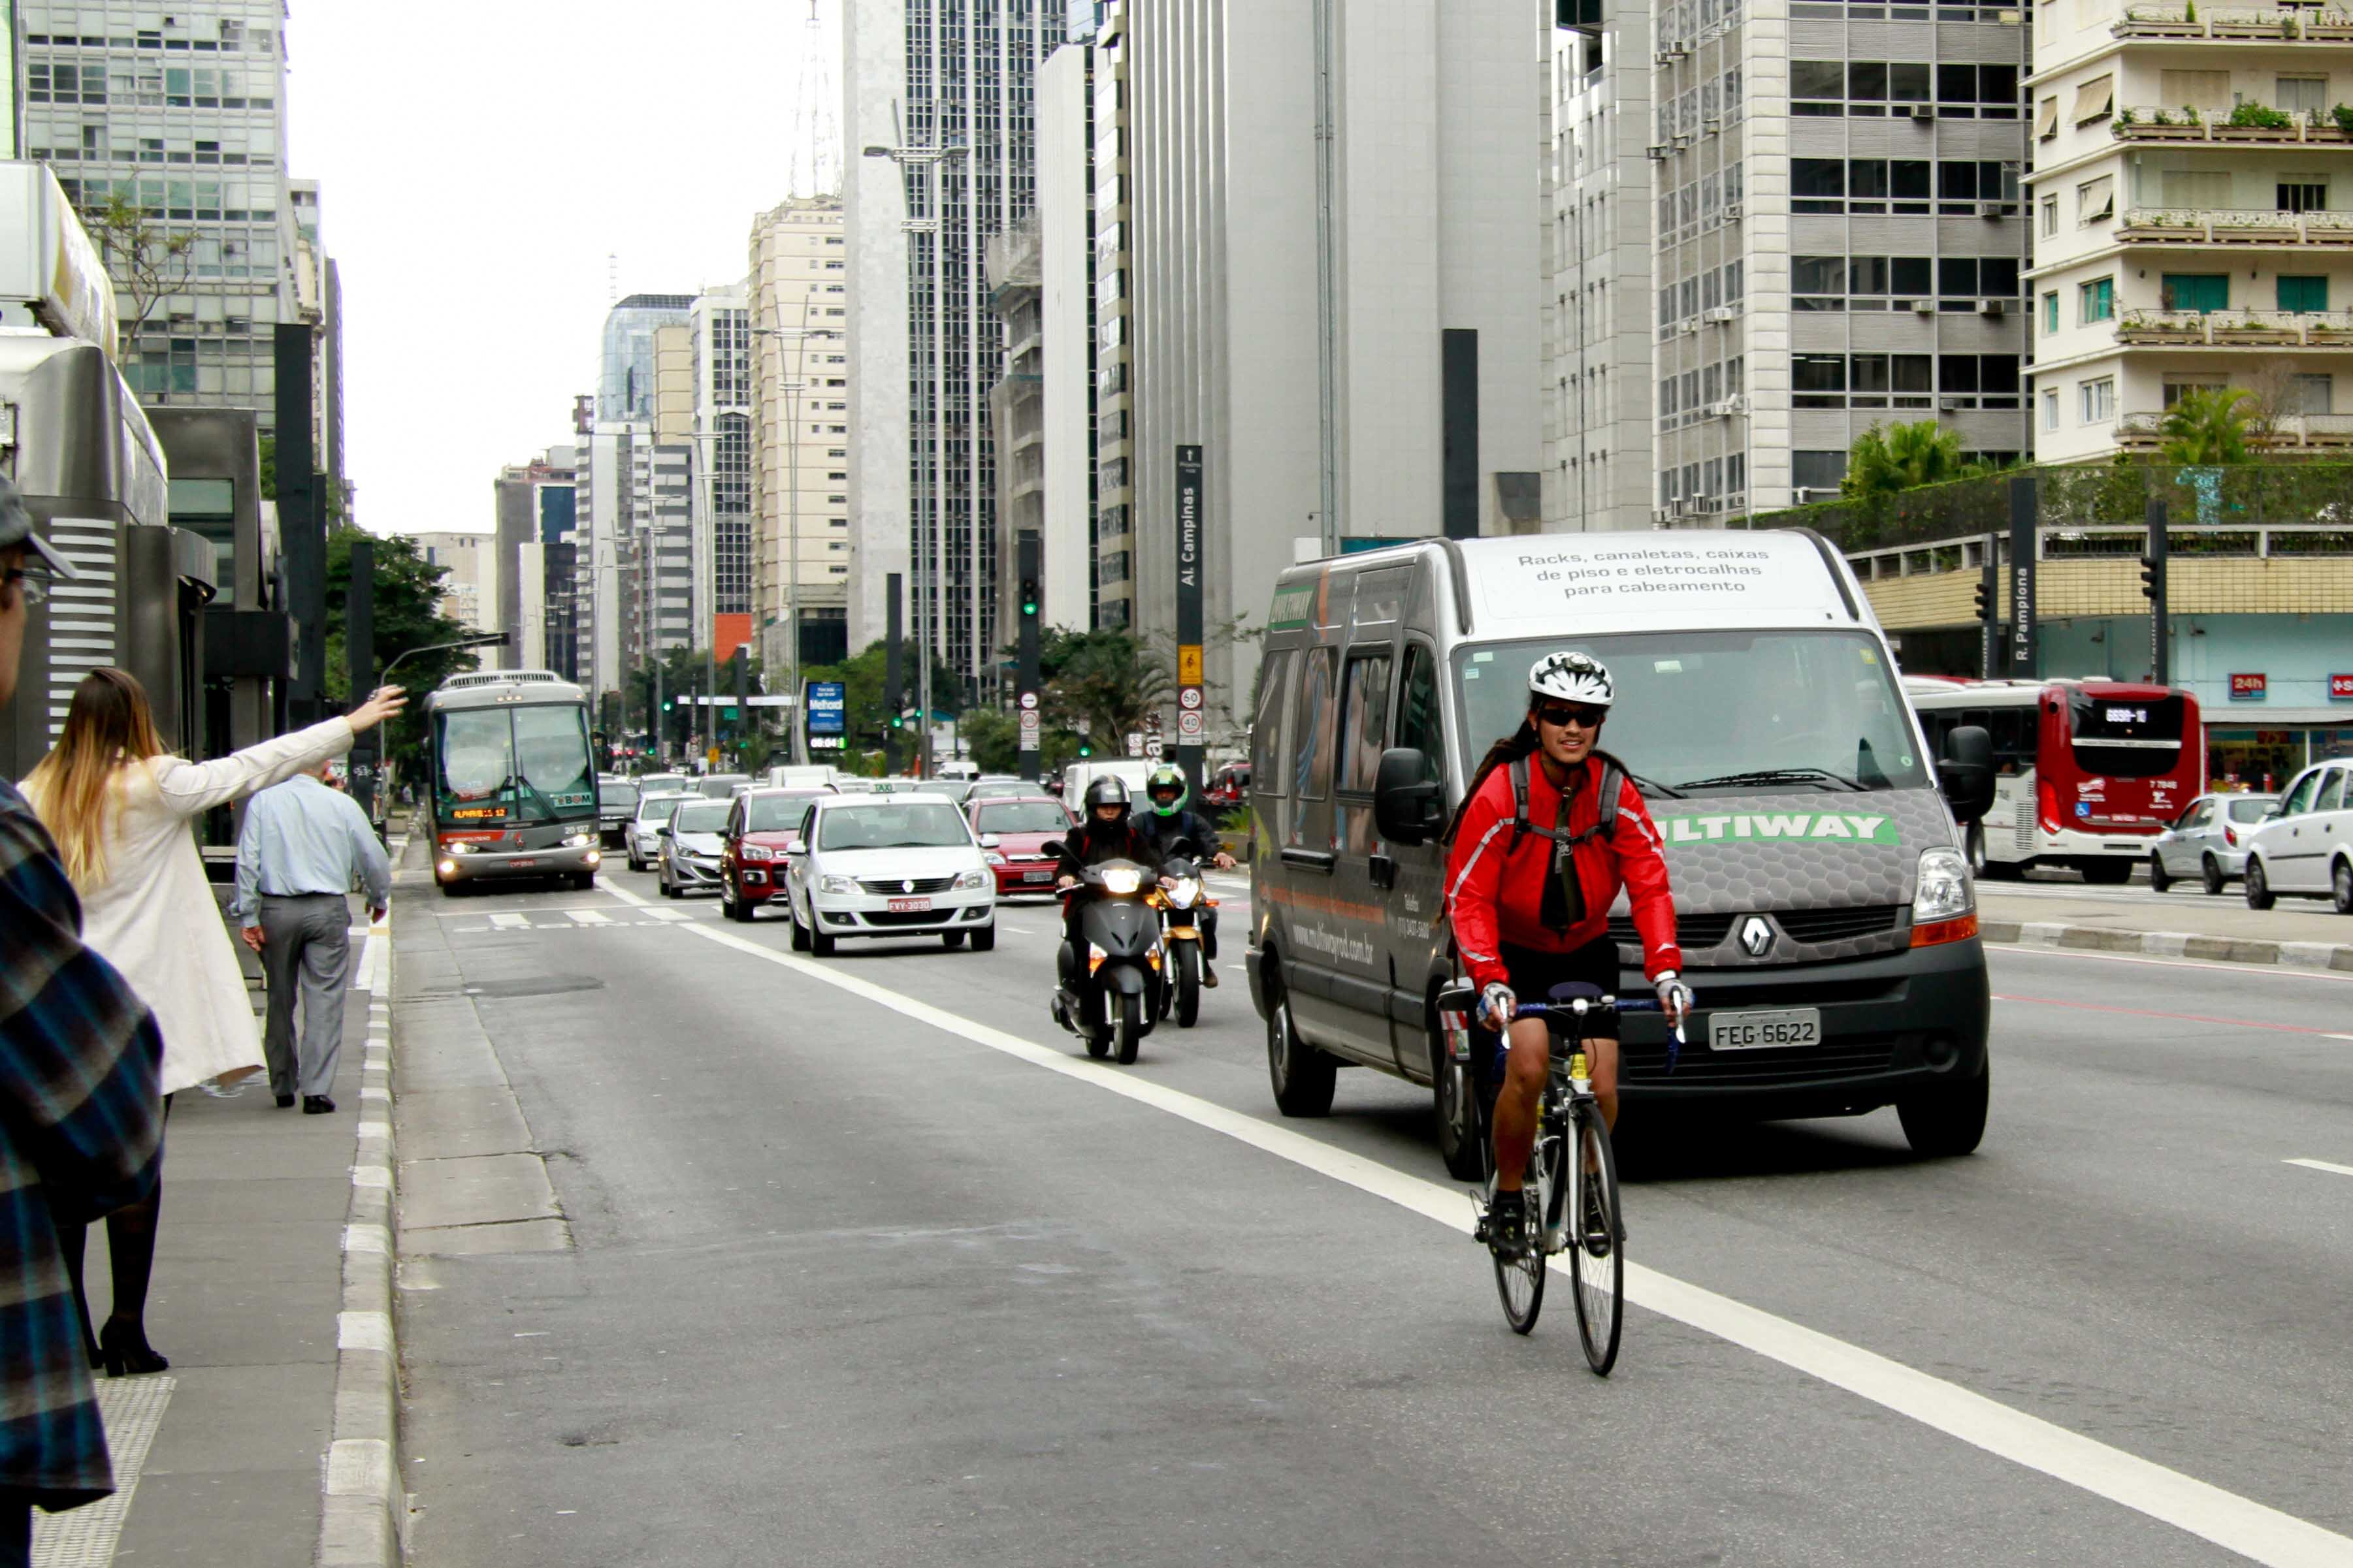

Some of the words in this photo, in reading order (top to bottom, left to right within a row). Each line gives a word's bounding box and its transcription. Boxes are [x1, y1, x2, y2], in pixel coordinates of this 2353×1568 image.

[1181, 487, 1196, 563] Campinas
[1517, 553, 1588, 567] Racks,
[1594, 549, 1700, 561] canaletas,
[1706, 549, 1769, 560] caixas
[1181, 568, 1195, 586] Al.
[1536, 570, 1561, 581] de
[1568, 568, 1610, 582] piso
[1617, 568, 1628, 576] e
[1634, 564, 1762, 576] eletrocalhas
[1564, 585, 1612, 598] para
[1619, 581, 1745, 593] cabeamento
[2015, 568, 2030, 643] Pamplona
[2015, 647, 2028, 660] R.
[2234, 677, 2264, 689] 24h
[1184, 693, 1197, 702] 60
[1715, 1022, 1814, 1045] FEG-6622
